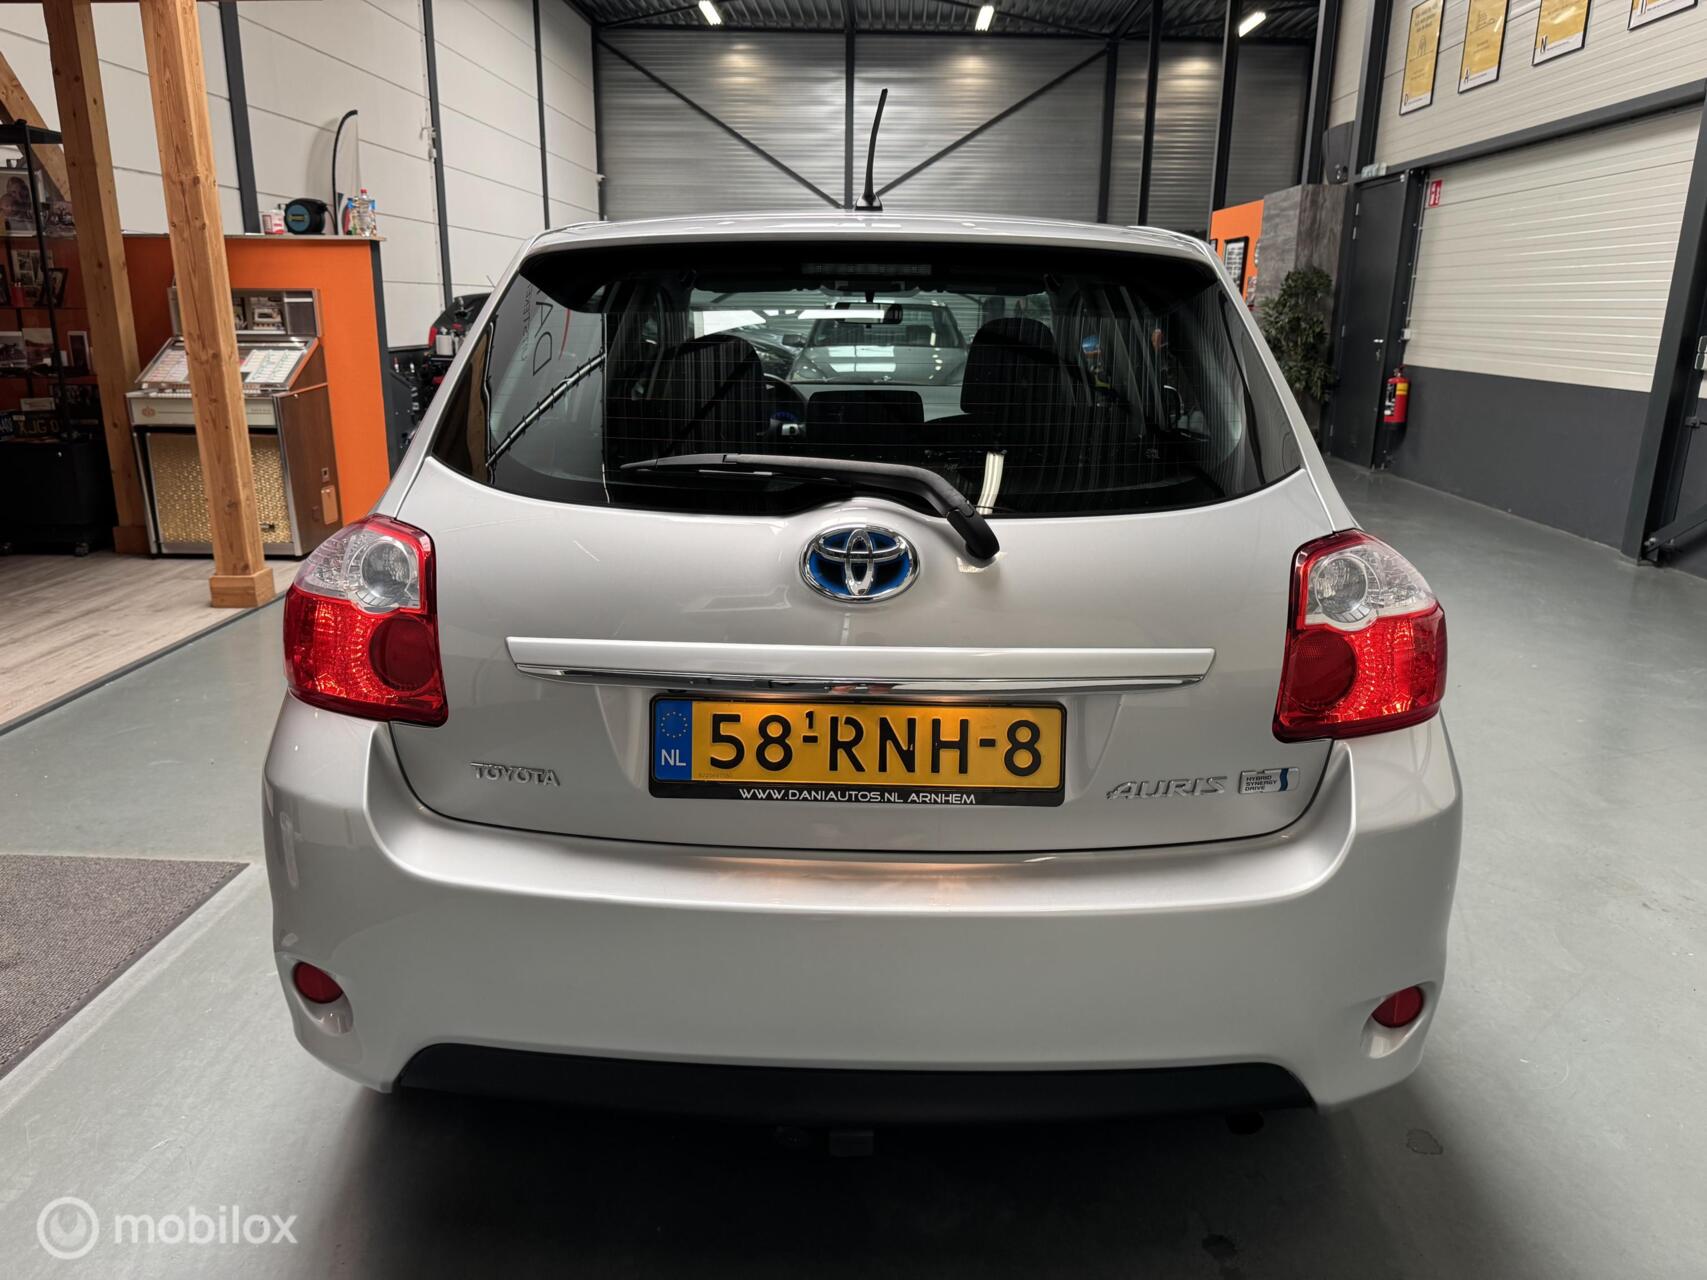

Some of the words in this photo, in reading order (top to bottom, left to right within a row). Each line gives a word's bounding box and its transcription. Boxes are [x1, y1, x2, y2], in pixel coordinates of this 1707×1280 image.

[660, 748, 687, 767] NL
[710, 713, 1042, 777] 58-RNH-8
[470, 762, 560, 787] TOYOTA
[739, 788, 904, 803] WWW.DANIAUTOS.NL
[908, 792, 976, 805] ARNHEM
[1106, 775, 1227, 800] AURIS
